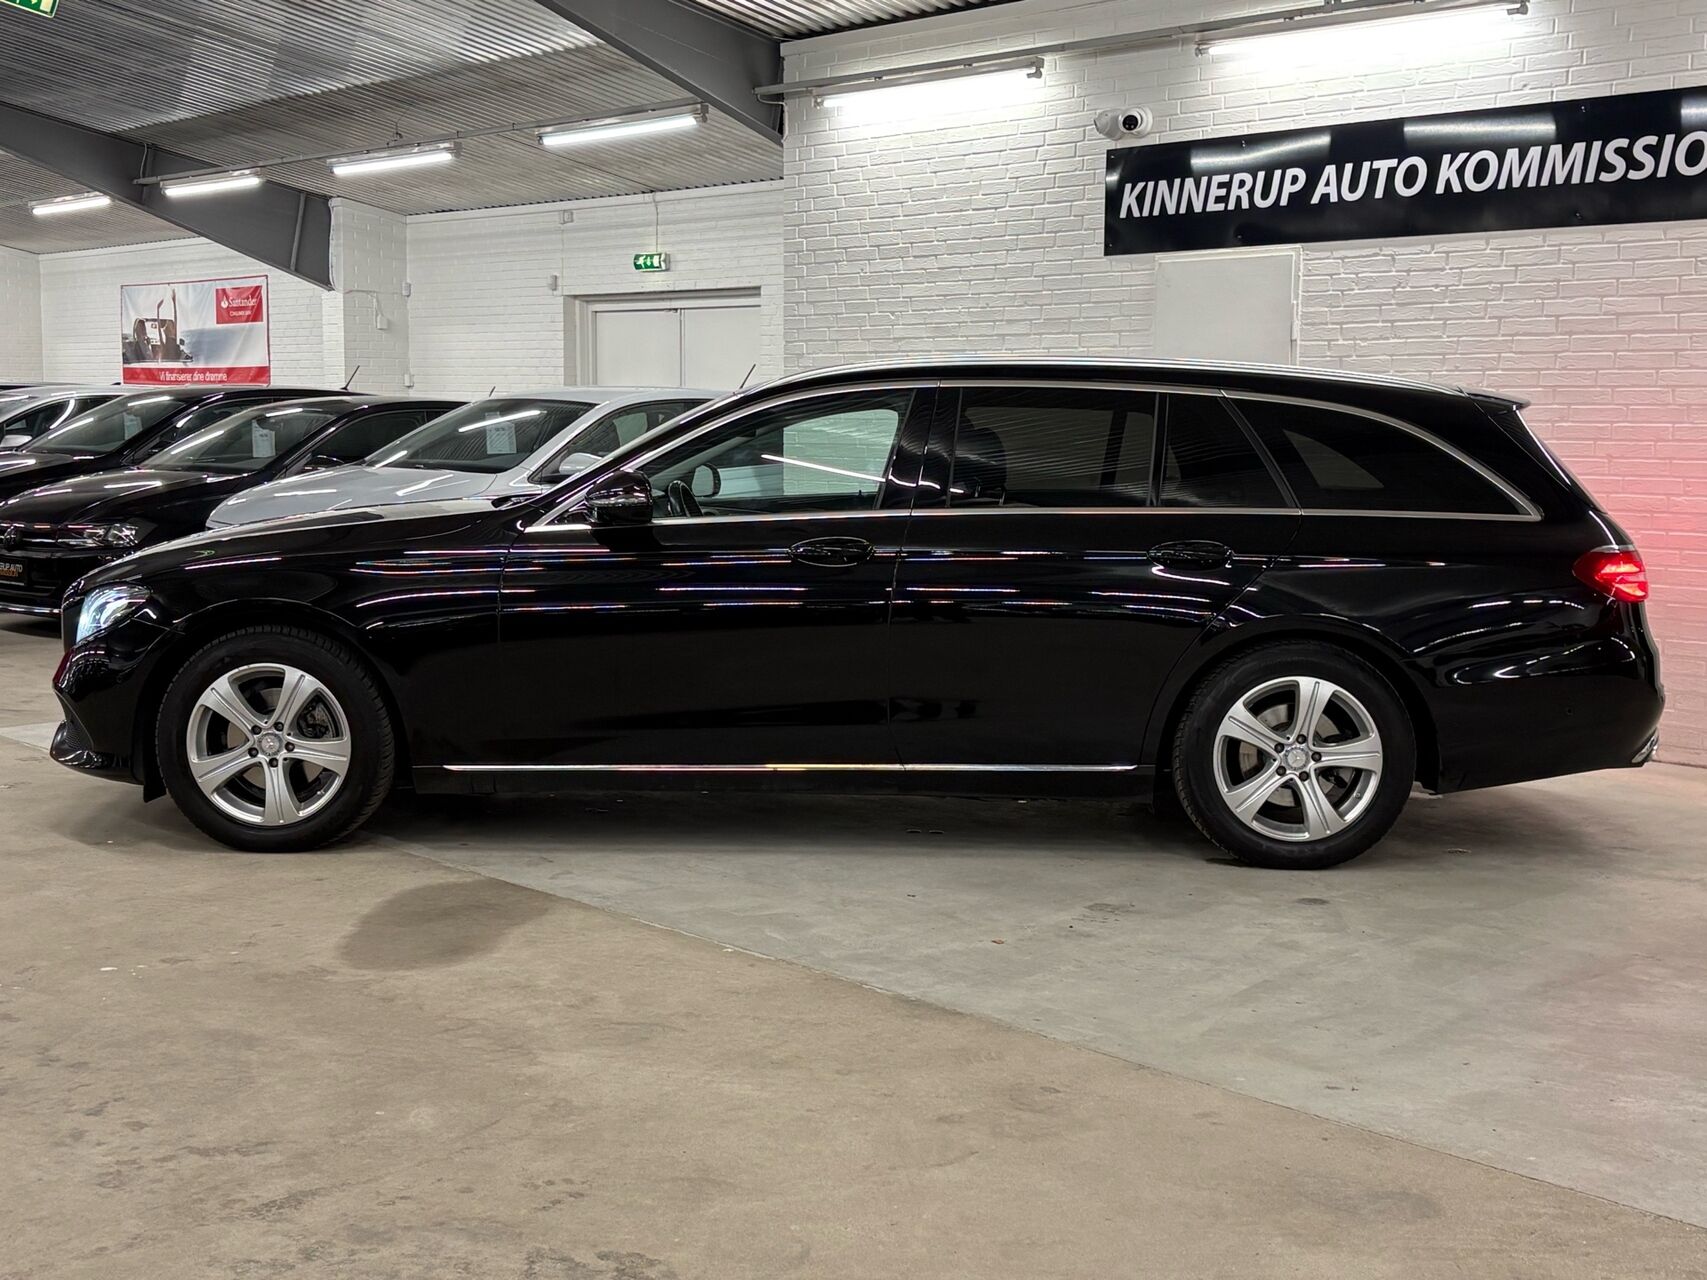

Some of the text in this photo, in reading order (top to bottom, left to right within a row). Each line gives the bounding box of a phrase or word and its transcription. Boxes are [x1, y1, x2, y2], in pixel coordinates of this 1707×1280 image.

[1119, 130, 1707, 219] KINNERUP AUTO KOMMISSIO
[228, 295, 257, 307] Santander
